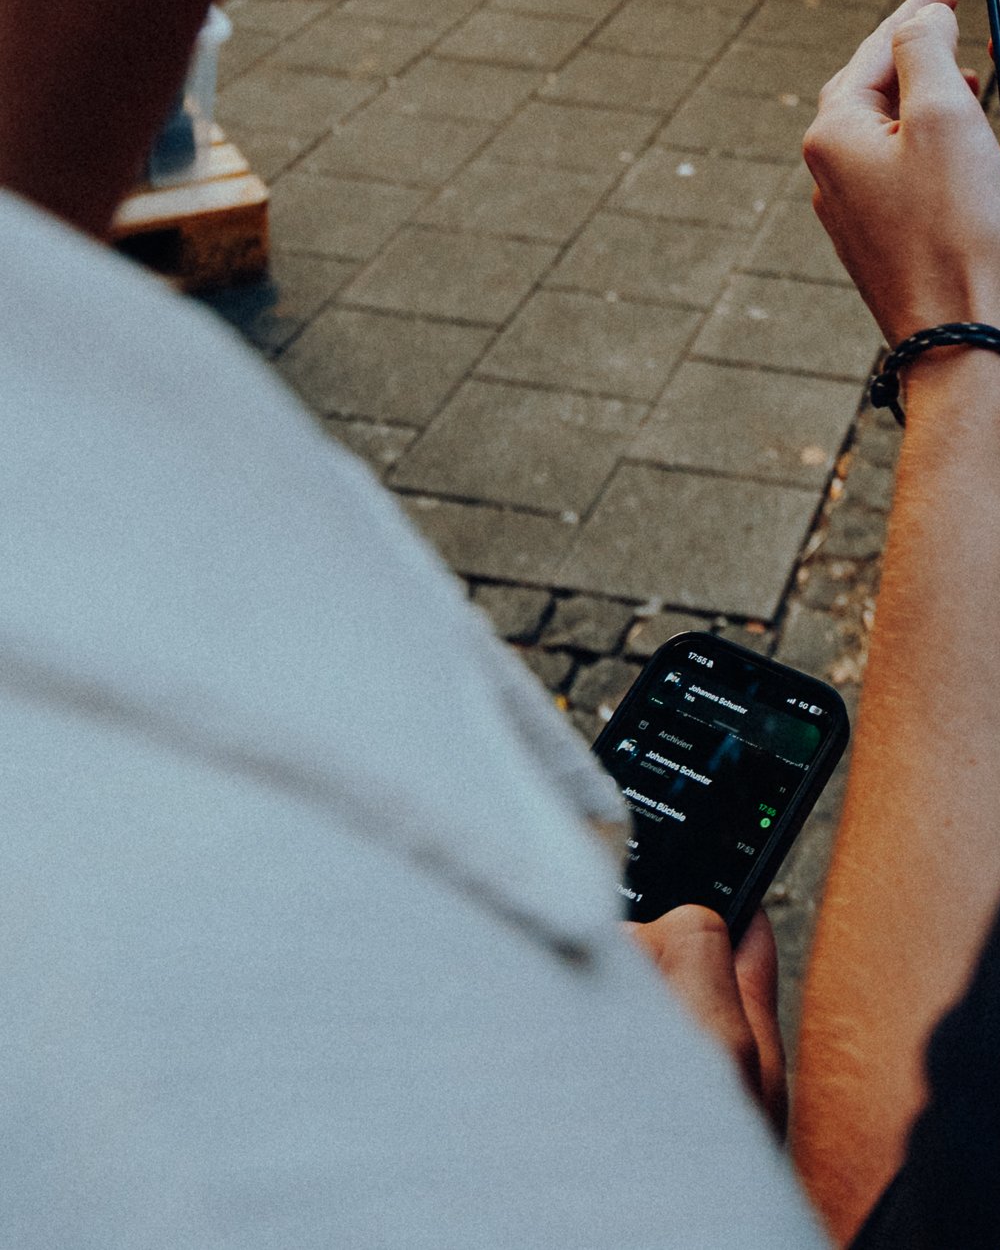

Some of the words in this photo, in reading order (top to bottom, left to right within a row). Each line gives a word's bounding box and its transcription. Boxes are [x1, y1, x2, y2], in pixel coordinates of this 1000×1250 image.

[688, 651, 707, 665] 17:55
[684, 692, 696, 703] Yes
[688, 684, 720, 702] Johannes
[718, 697, 748, 715] Schuster
[658, 730, 693, 750] Archiviert
[645, 750, 680, 771] Johannes
[679, 764, 713, 786] Schuster
[622, 786, 659, 809] Johannes
[758, 803, 777, 817] 17:55
[736, 840, 756, 856] 17:53
[713, 881, 733, 895] 17:40
